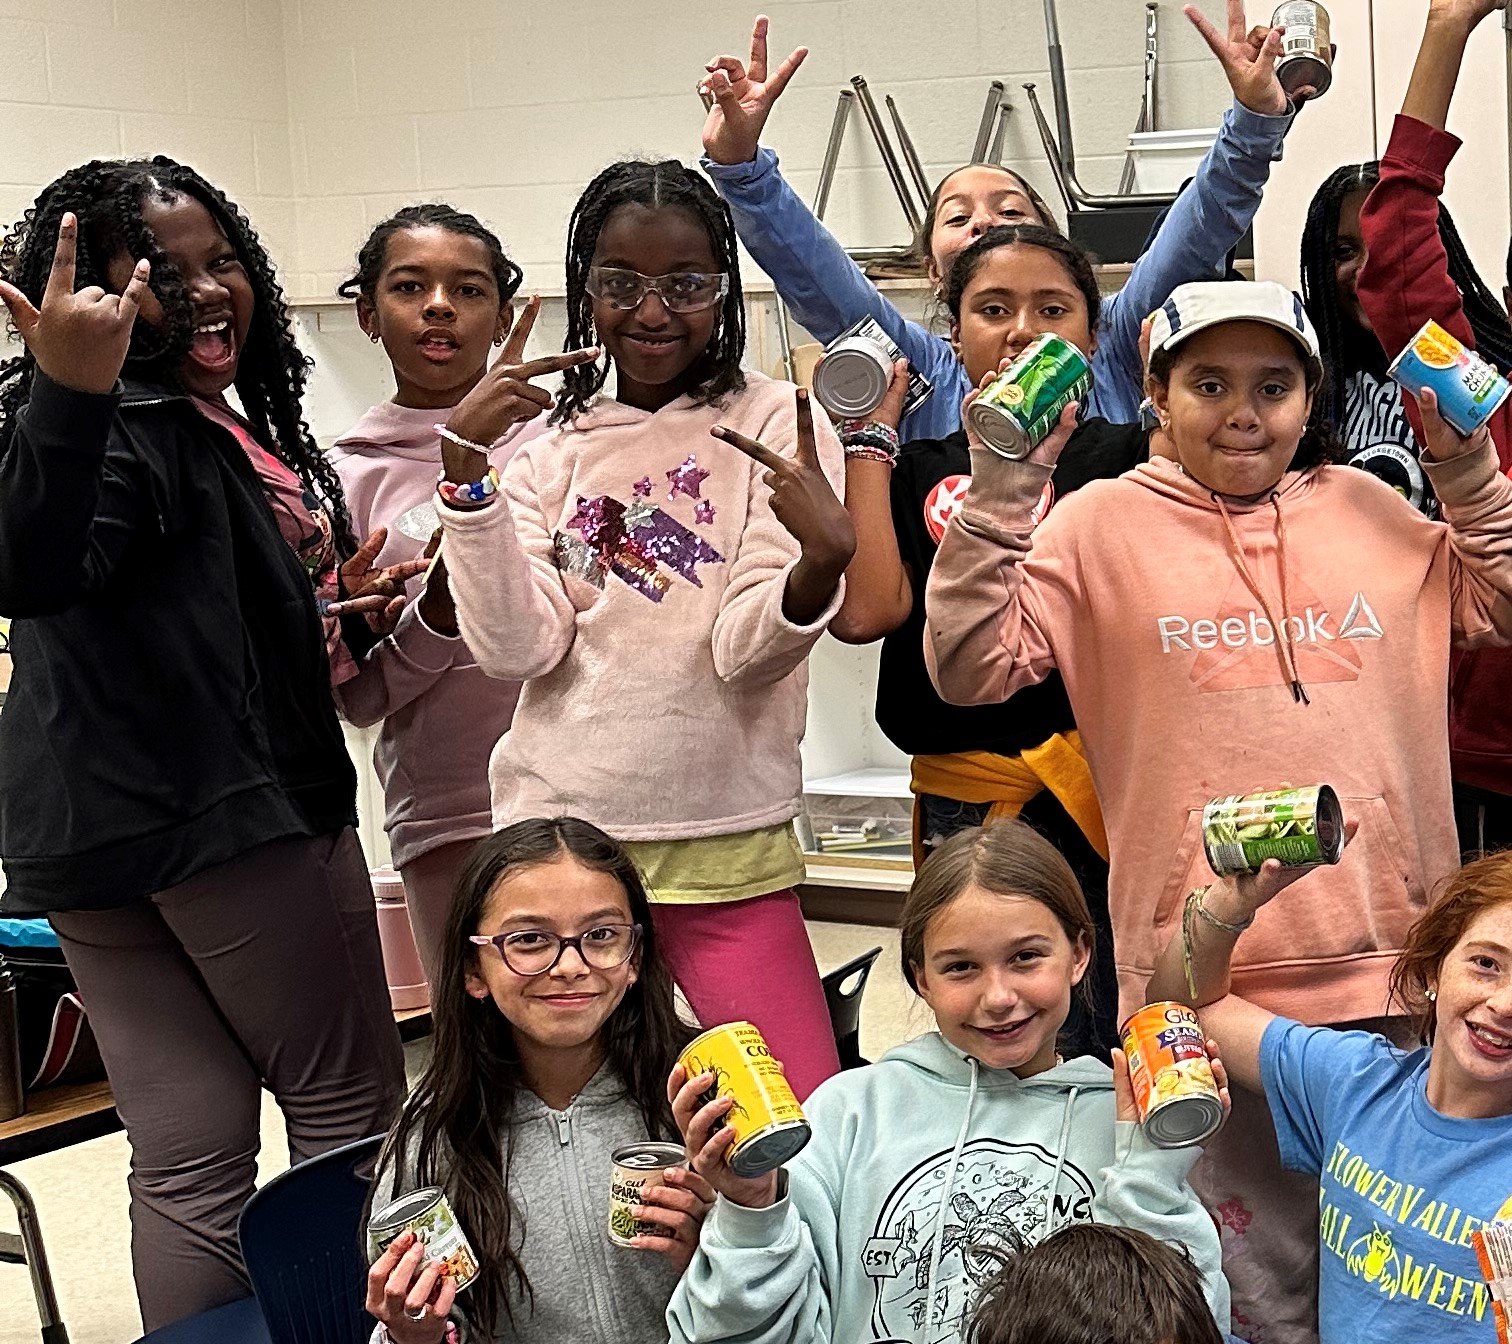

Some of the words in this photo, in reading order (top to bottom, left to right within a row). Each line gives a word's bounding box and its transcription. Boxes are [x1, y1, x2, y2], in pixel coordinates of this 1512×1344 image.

[1156, 607, 1336, 654] Reebok
[1326, 1140, 1402, 1217] FLOWER
[1396, 1184, 1489, 1249] VALLE
[865, 1250, 892, 1267] EST
